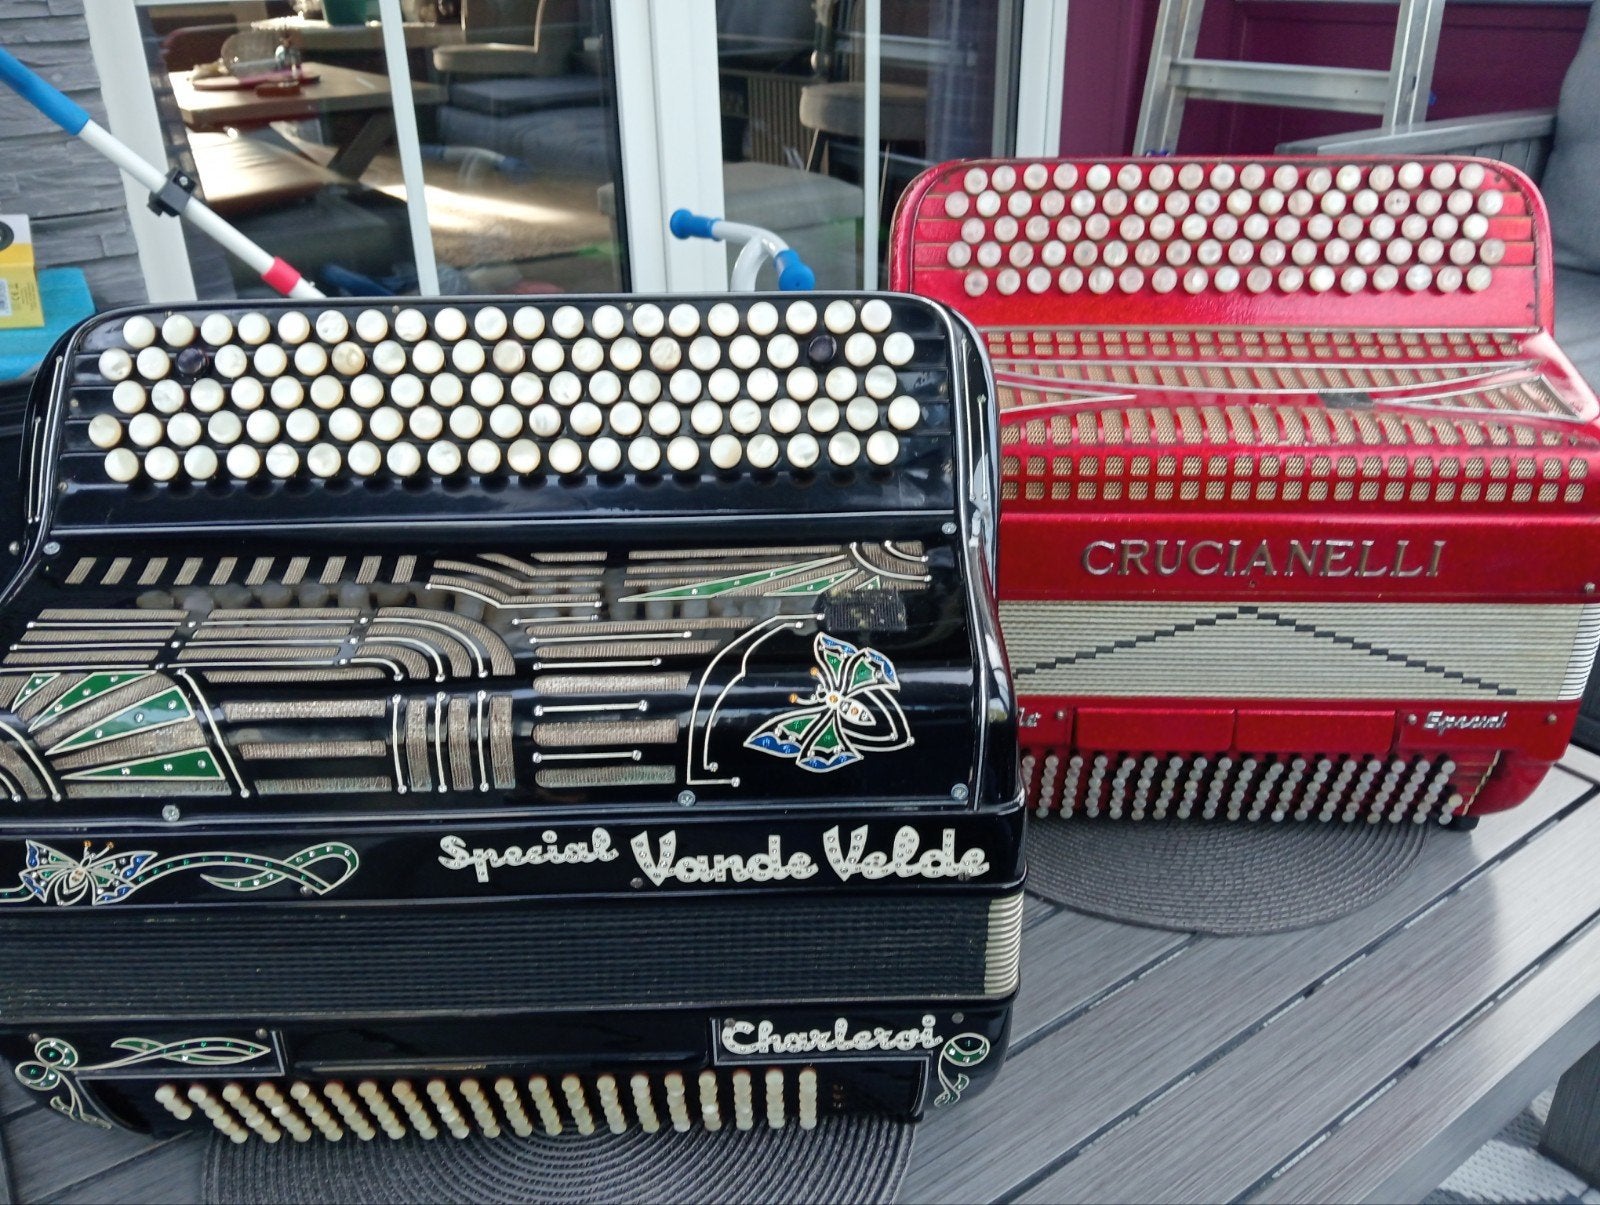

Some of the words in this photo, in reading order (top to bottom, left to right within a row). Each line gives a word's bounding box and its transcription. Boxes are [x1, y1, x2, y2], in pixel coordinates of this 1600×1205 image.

[1082, 539, 1447, 577] CRUCIANELLI
[438, 828, 619, 882] Special
[630, 830, 819, 886] Vande
[823, 825, 990, 881] Velde
[722, 1015, 943, 1053] Charleroi
